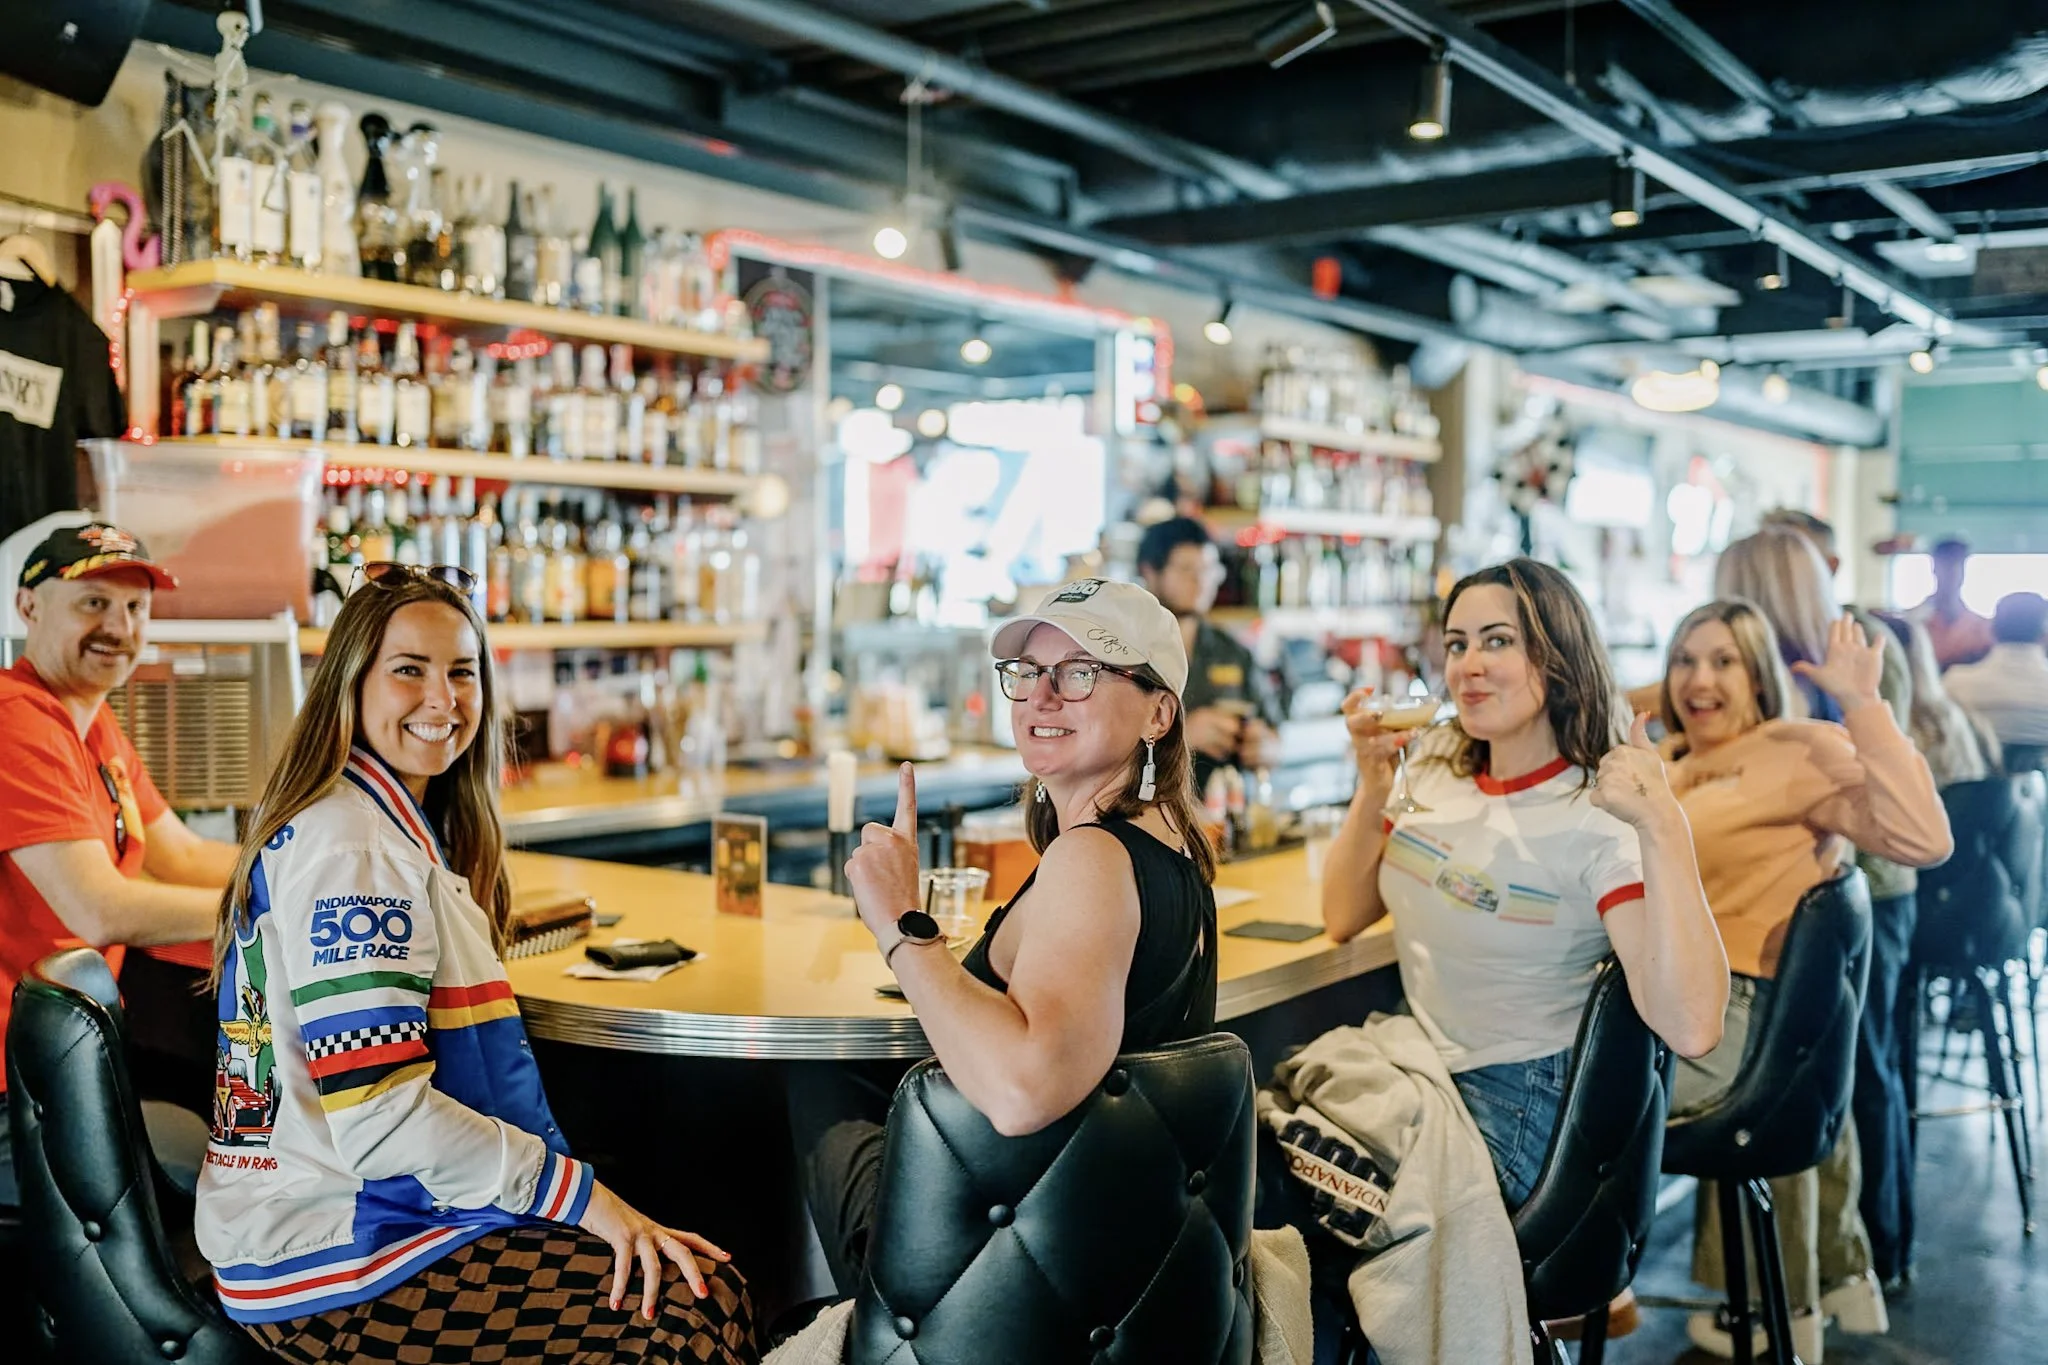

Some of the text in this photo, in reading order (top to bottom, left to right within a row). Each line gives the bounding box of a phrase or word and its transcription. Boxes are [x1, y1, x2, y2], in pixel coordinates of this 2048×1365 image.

[315, 895, 412, 911] INDIANAPOLIS
[310, 906, 412, 947] 500
[312, 943, 410, 967] MILE RACE
[237, 1155, 251, 1169] IN
